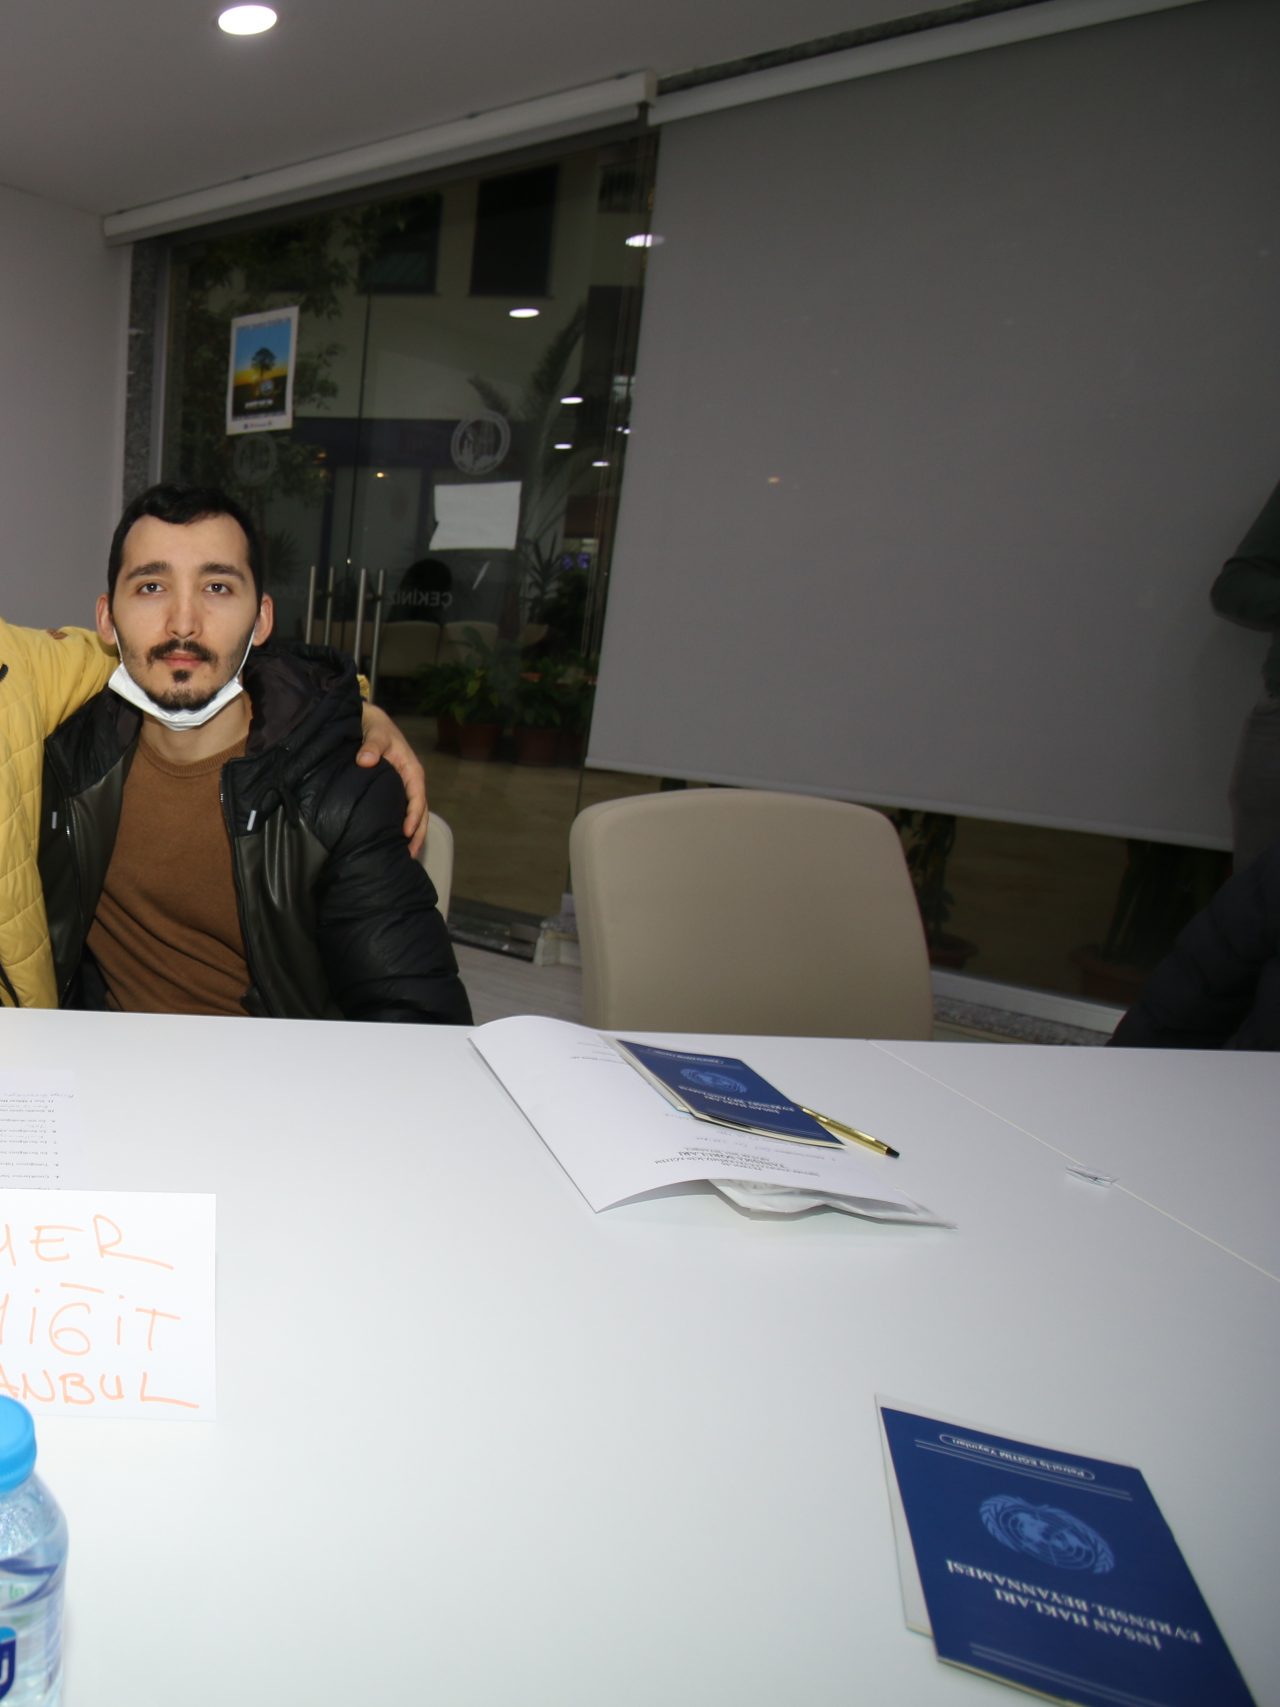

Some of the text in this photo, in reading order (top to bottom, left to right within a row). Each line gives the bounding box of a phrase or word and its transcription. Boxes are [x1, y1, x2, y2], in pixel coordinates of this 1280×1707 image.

[945, 1559, 1203, 1645] EVRENSEL BEYANNAMESİ
[993, 1588, 1163, 1651] İNSAN HAKLARI
